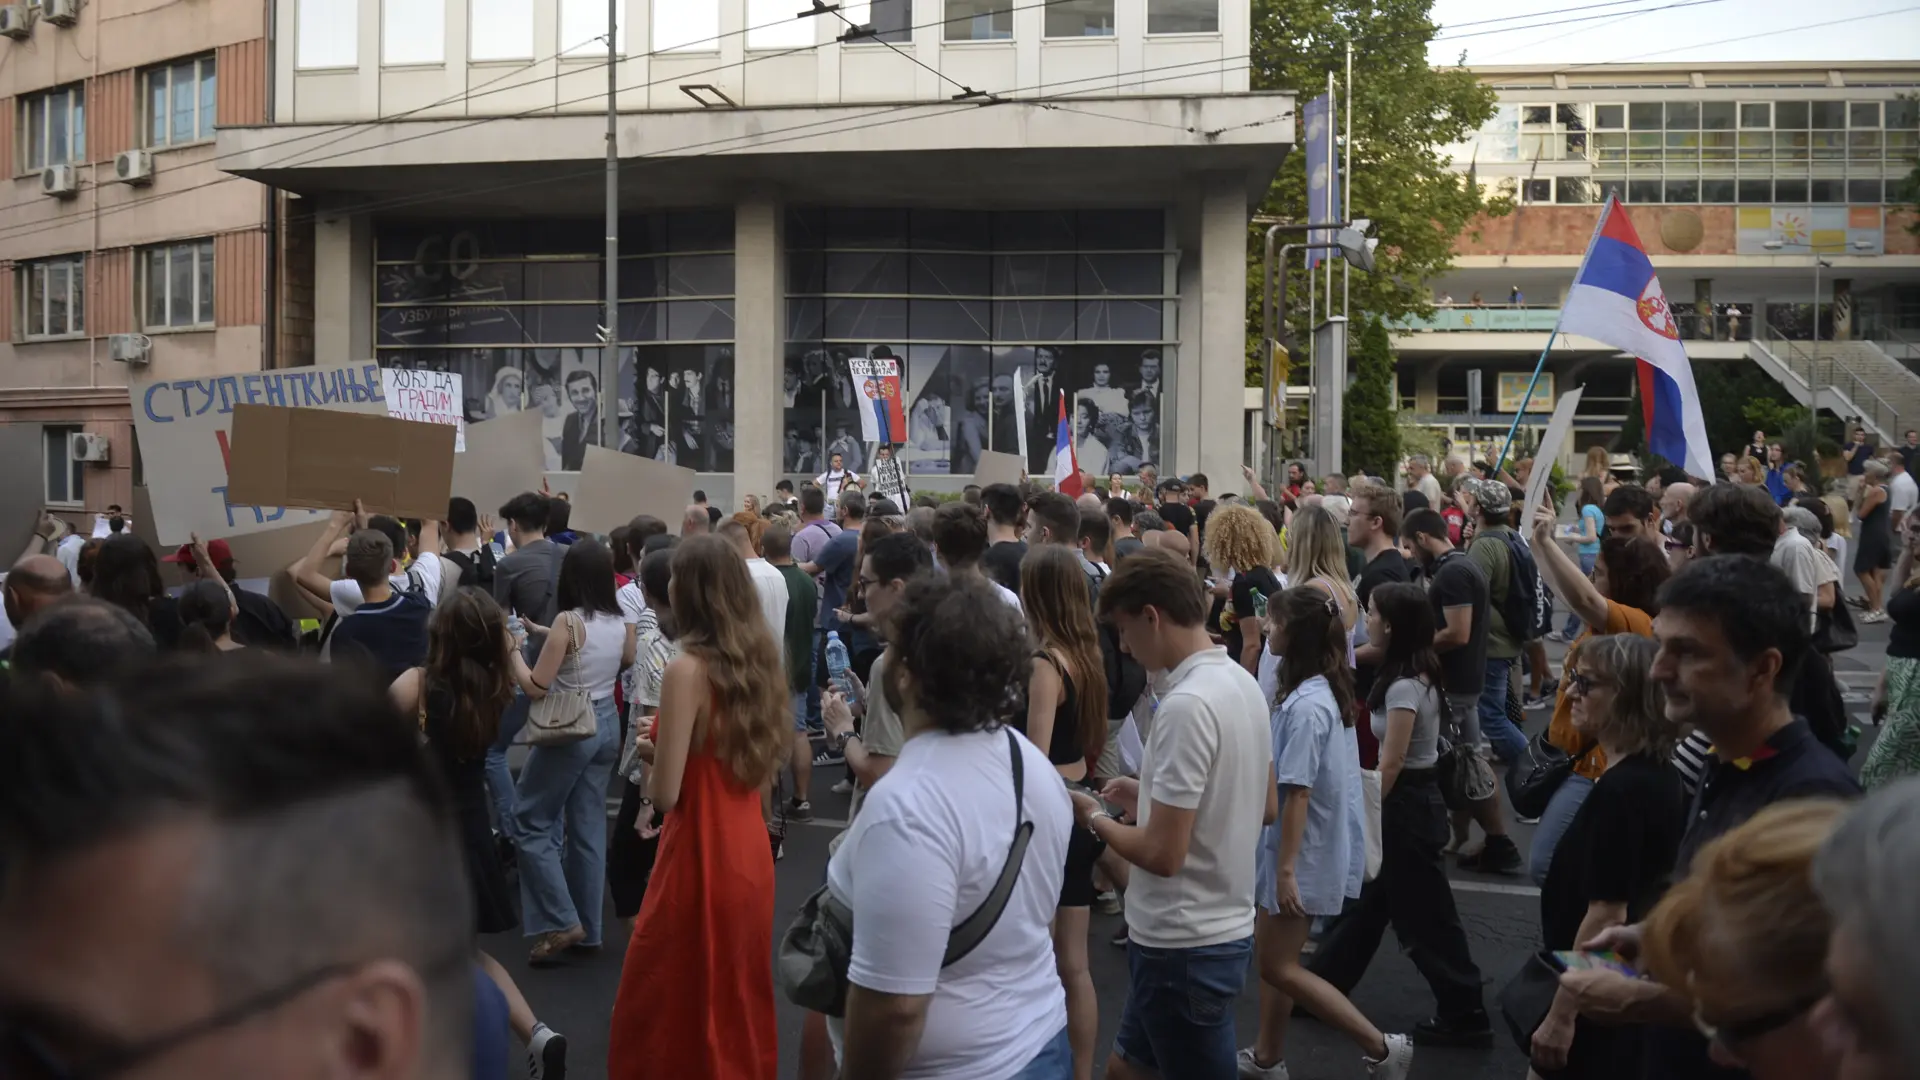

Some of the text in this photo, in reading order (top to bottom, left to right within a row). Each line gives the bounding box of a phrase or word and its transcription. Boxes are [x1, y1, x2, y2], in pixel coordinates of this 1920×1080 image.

[143, 364, 386, 423] СТУДЕНТКИЊЕ
[392, 369, 455, 394] ХОЋУ ДА
[397, 389, 453, 414] ГРАДИМ
[1535, 570, 1545, 629] adida
